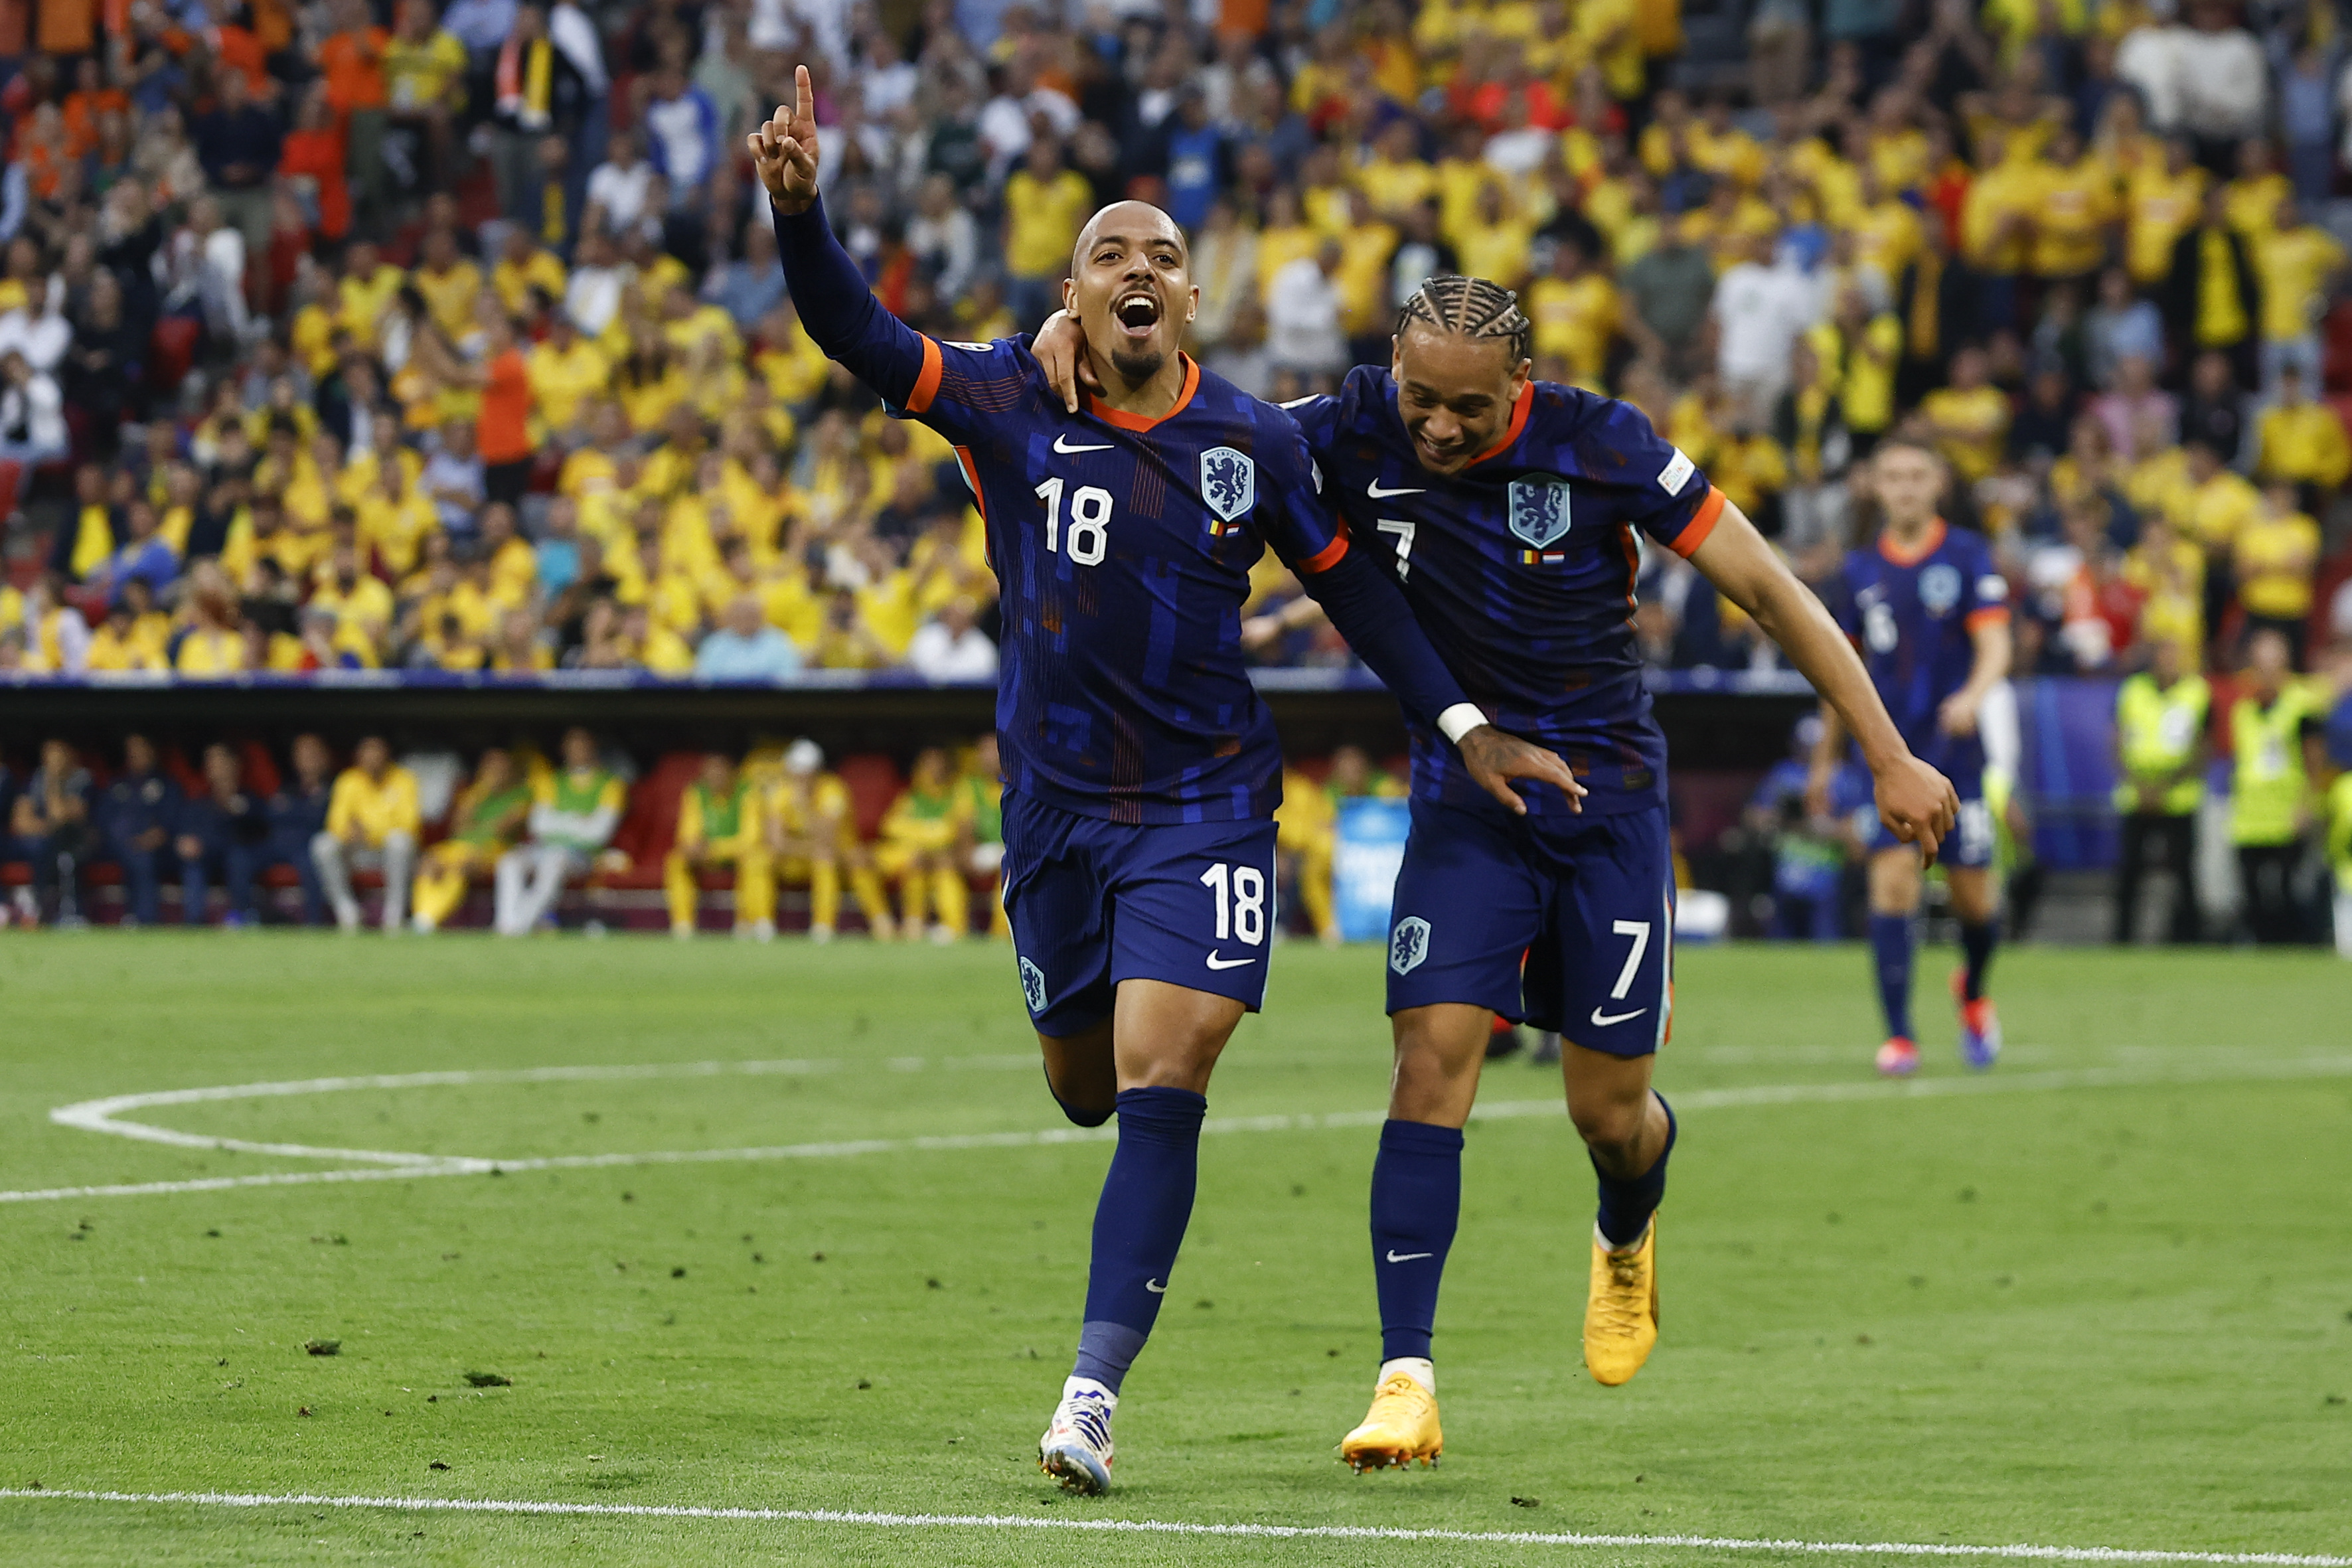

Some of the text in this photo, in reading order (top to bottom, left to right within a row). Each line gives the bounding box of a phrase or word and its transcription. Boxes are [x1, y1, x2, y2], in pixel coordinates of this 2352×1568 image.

[1034, 477, 1114, 566] 18
[1376, 518, 1416, 584] 7
[1200, 863, 1265, 946] 18
[1610, 919, 1651, 1000] 7
